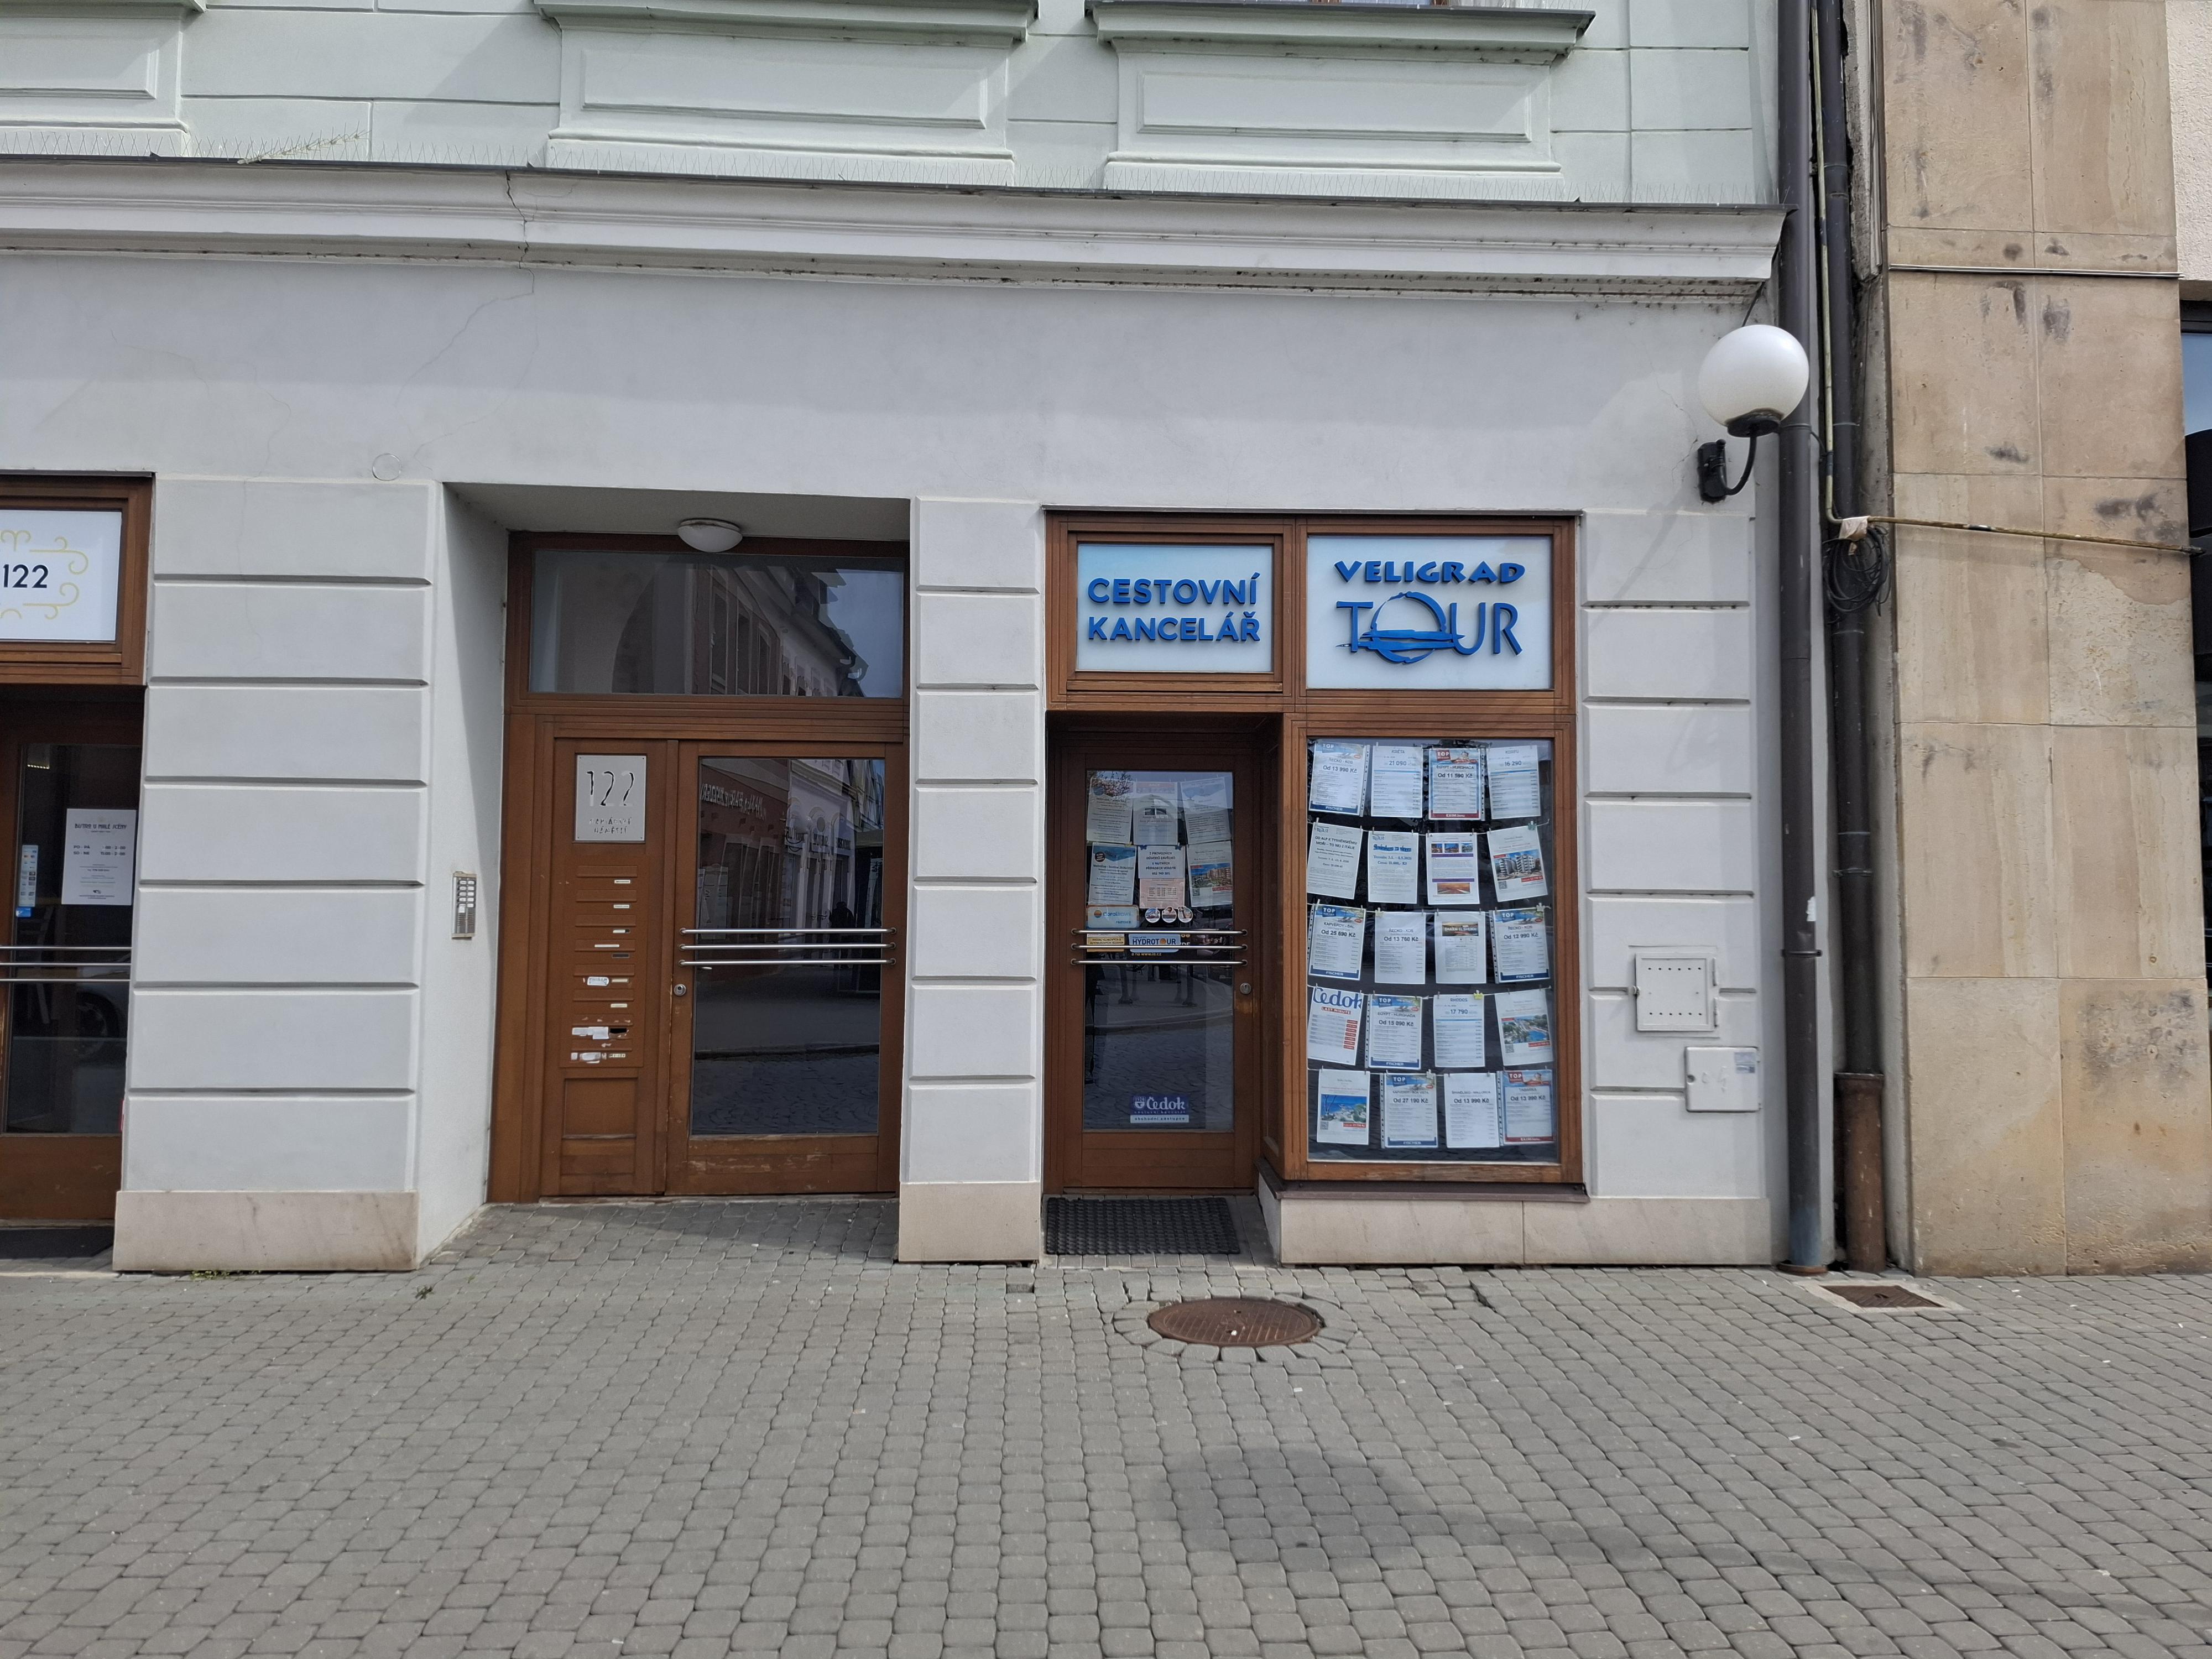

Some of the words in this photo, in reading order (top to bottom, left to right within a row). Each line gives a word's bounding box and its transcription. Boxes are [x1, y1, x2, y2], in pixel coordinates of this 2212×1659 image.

[3, 564, 49, 588] 122
[1334, 560, 1525, 584] VELIGRAD
[1088, 572, 1259, 605] CESTOVNÍ
[1088, 611, 1260, 642] KANCELÁŘ
[1336, 591, 1524, 664] TOUR
[587, 771, 634, 806] 122
[1146, 1097, 1186, 1109] Čedok
